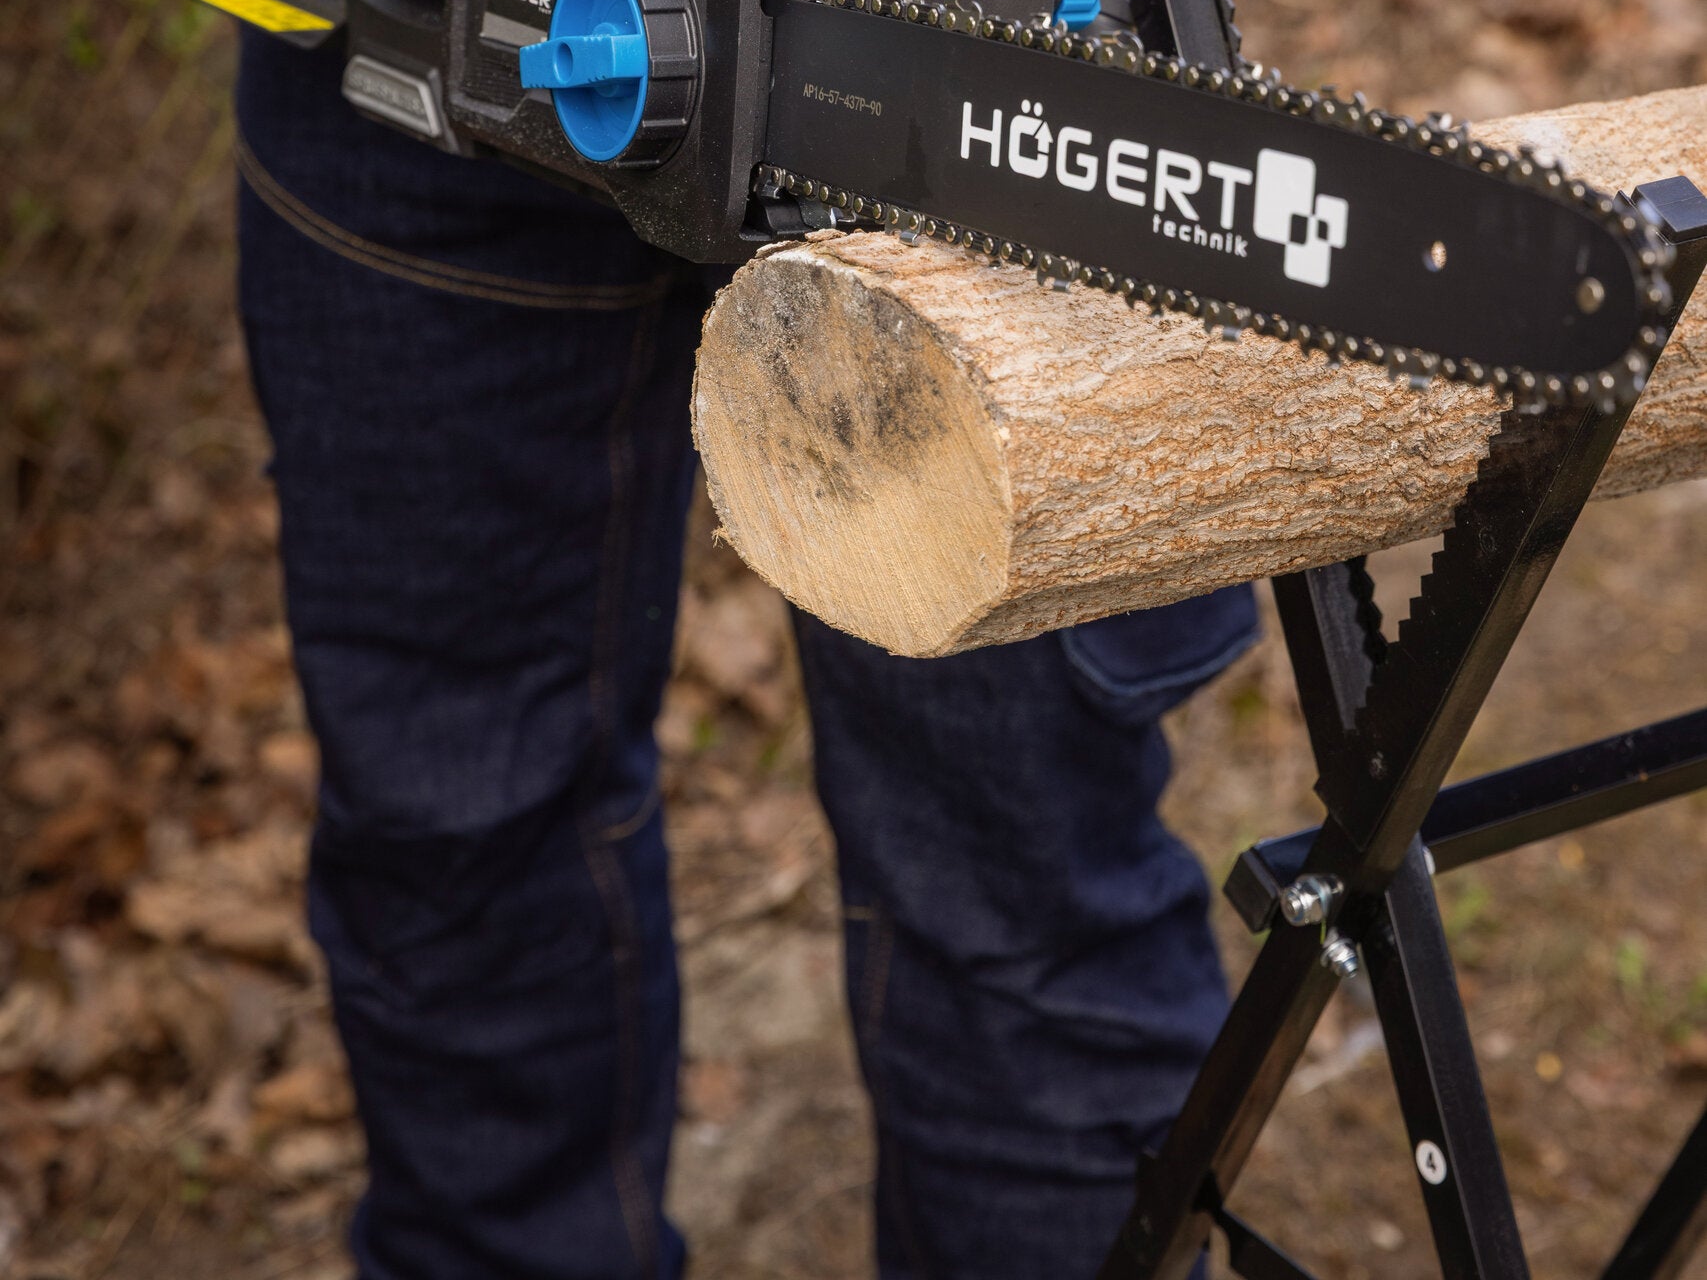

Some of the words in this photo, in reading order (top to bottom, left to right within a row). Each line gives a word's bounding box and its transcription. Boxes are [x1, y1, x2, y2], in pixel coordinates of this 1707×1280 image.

[803, 82, 882, 117] AP16-57-437P-90
[960, 98, 1254, 230] HÖGERT
[1151, 213, 1249, 258] technik
[1425, 1151, 1437, 1174] 4
